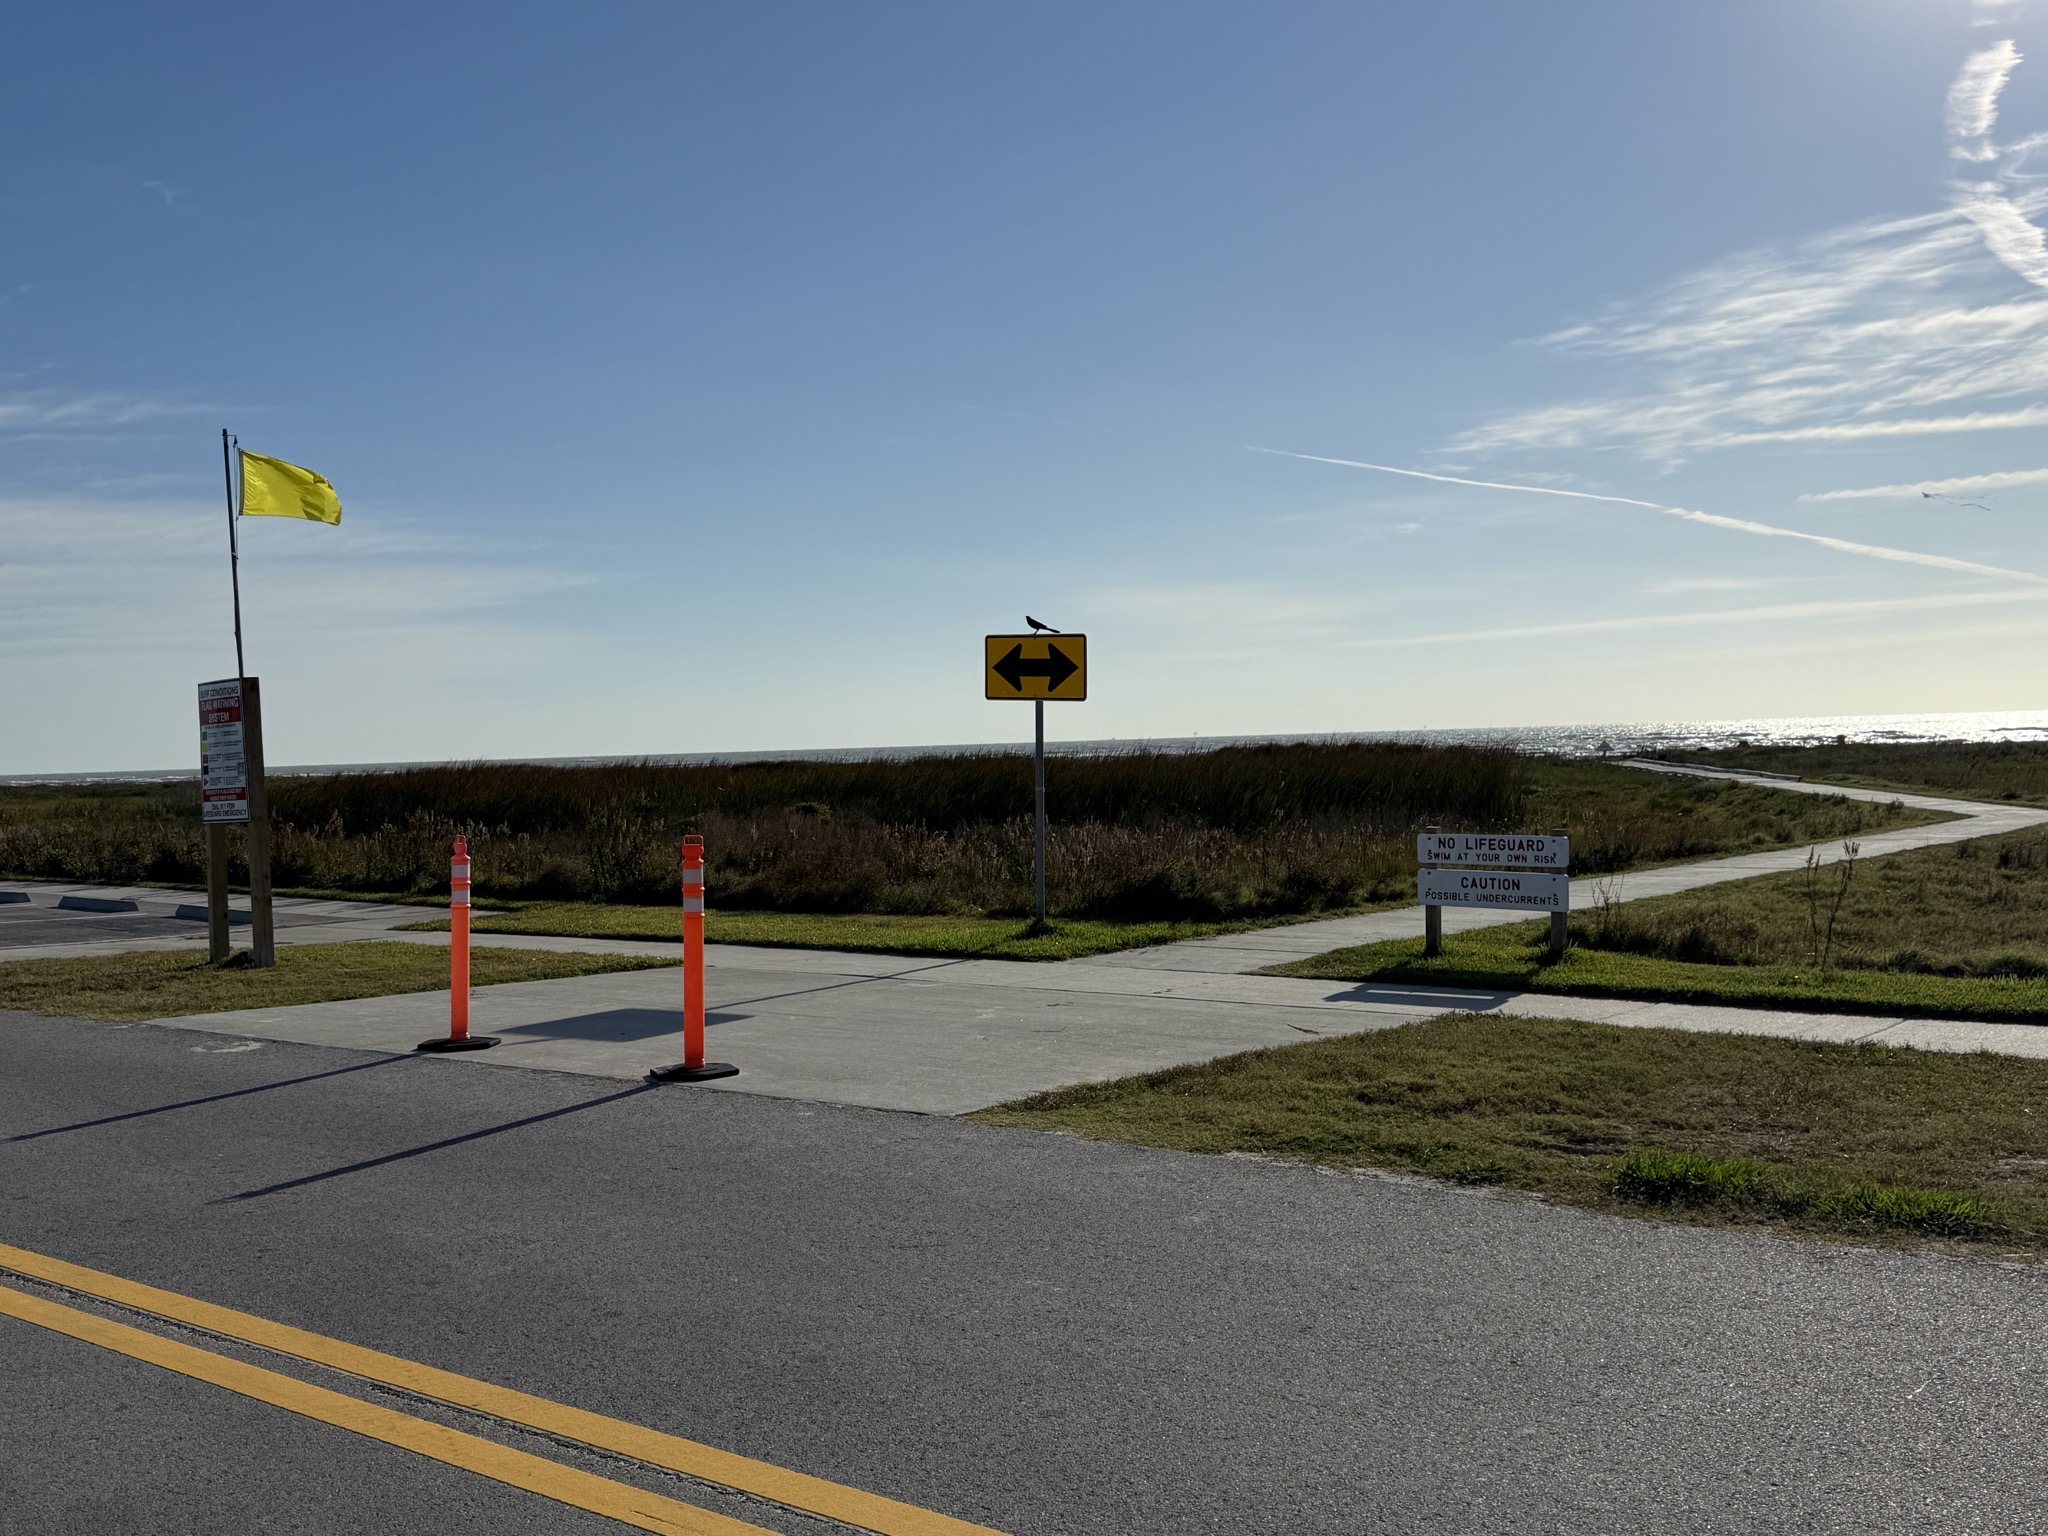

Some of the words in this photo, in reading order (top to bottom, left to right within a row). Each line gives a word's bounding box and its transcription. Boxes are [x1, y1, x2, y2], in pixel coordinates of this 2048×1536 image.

[210, 686, 239, 697] CONDITIONS
[201, 701, 212, 711] FLAG
[213, 697, 239, 709] WARNING
[208, 712, 230, 724] SYSTEM
[1438, 837, 1455, 849] NO
[1465, 838, 1545, 852] LIFEGUARD
[1427, 852, 1451, 861] SWIM
[1457, 853, 1468, 861] AT
[1476, 853, 1500, 862] YOUR
[1507, 854, 1527, 863] OWN
[1534, 855, 1556, 864] RISK
[1461, 877, 1521, 891] CAUTION
[1425, 892, 1470, 901] POSSIBLE
[1476, 893, 1559, 906] UNDERCURRENTS
